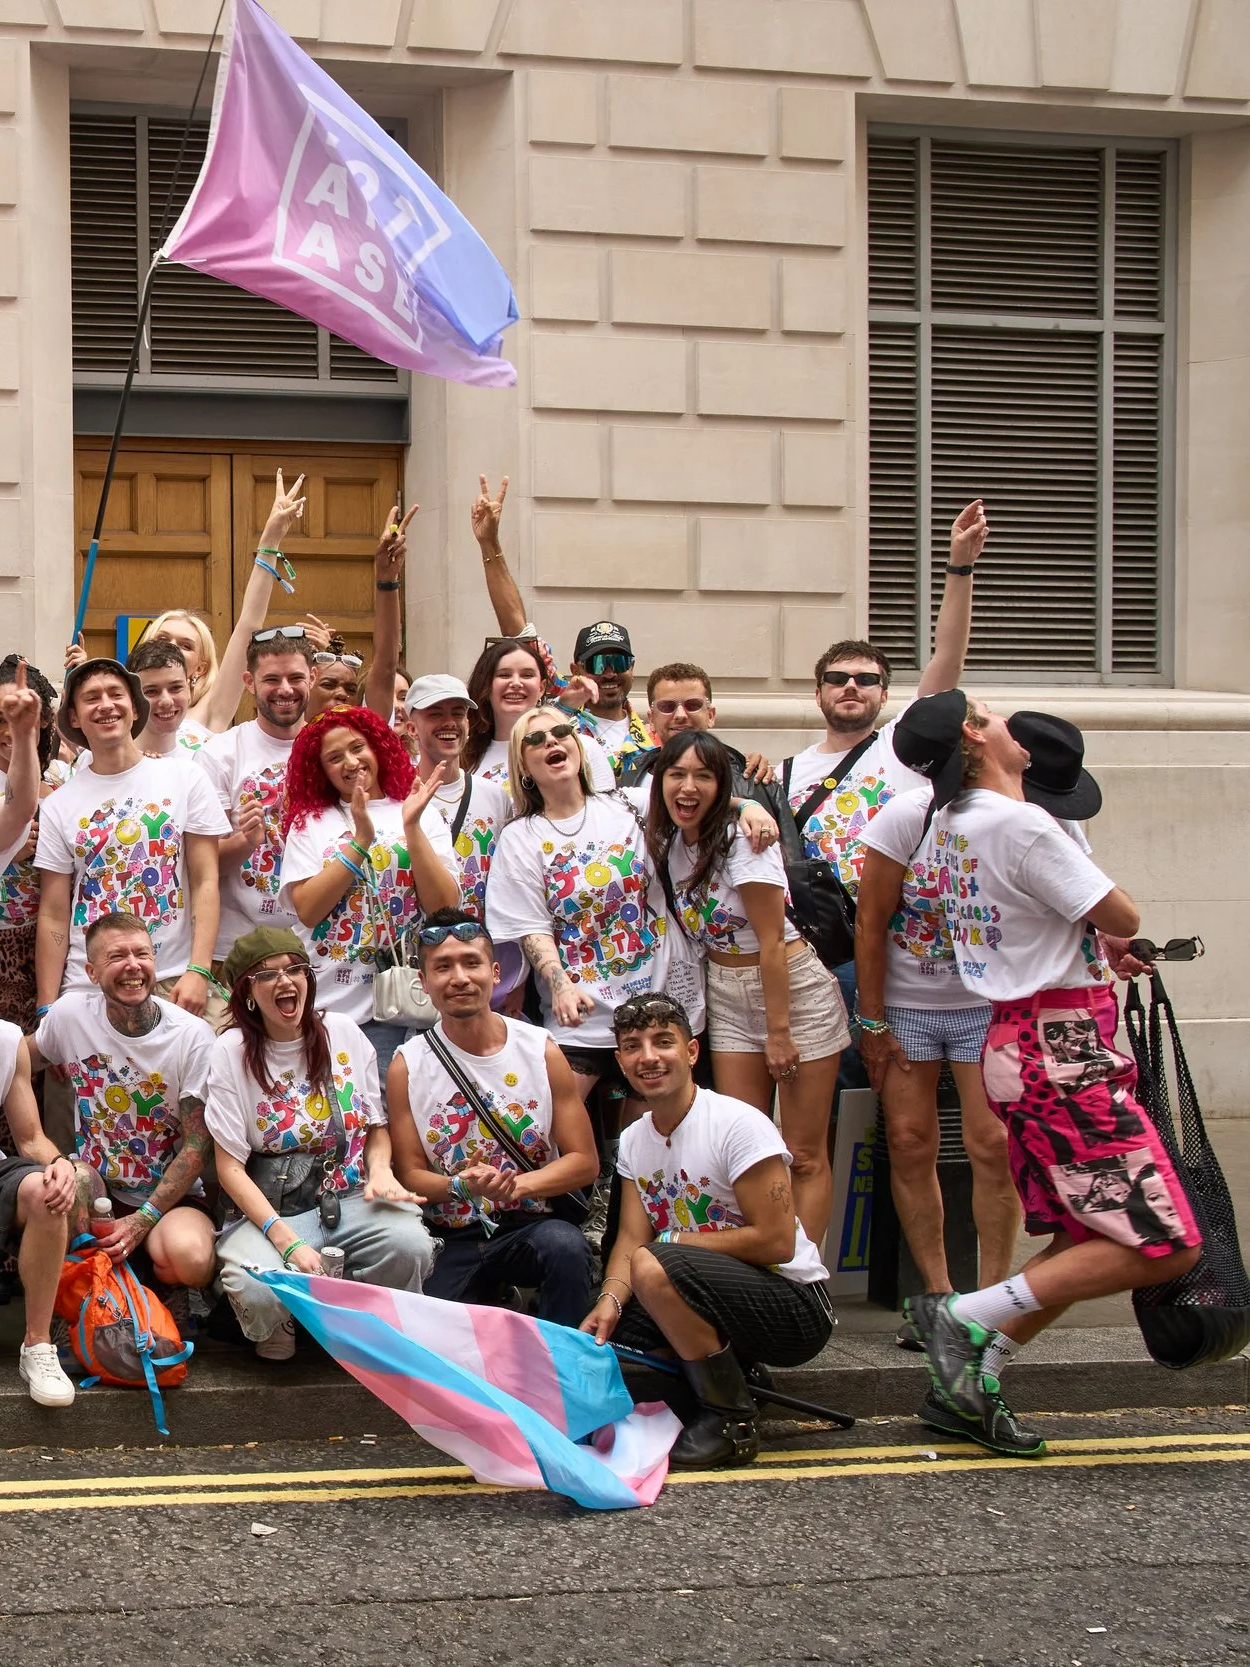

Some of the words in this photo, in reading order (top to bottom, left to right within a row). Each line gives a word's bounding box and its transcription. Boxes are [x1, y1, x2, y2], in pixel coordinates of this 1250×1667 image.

[89, 811, 170, 854] JOY
[808, 814, 838, 832] AS
[90, 847, 118, 869] AS
[130, 839, 165, 860] AN
[805, 836, 852, 858] ACT
[83, 871, 132, 896] ACT
[141, 864, 173, 887] OF
[379, 869, 414, 887] AN
[464, 856, 491, 874] AN
[553, 849, 635, 899] JOY
[962, 858, 978, 874] OF
[73, 888, 184, 926] RESISTANCE
[389, 896, 417, 916] OF
[563, 891, 593, 915] AS
[606, 874, 641, 900] AN
[561, 911, 611, 941] ACT
[78, 1072, 165, 1116] JOY
[272, 1082, 354, 1131] JOY
[78, 1098, 109, 1120] AS
[116, 1113, 155, 1132] AN
[281, 1123, 313, 1150] AS
[647, 1193, 713, 1230] JOY
